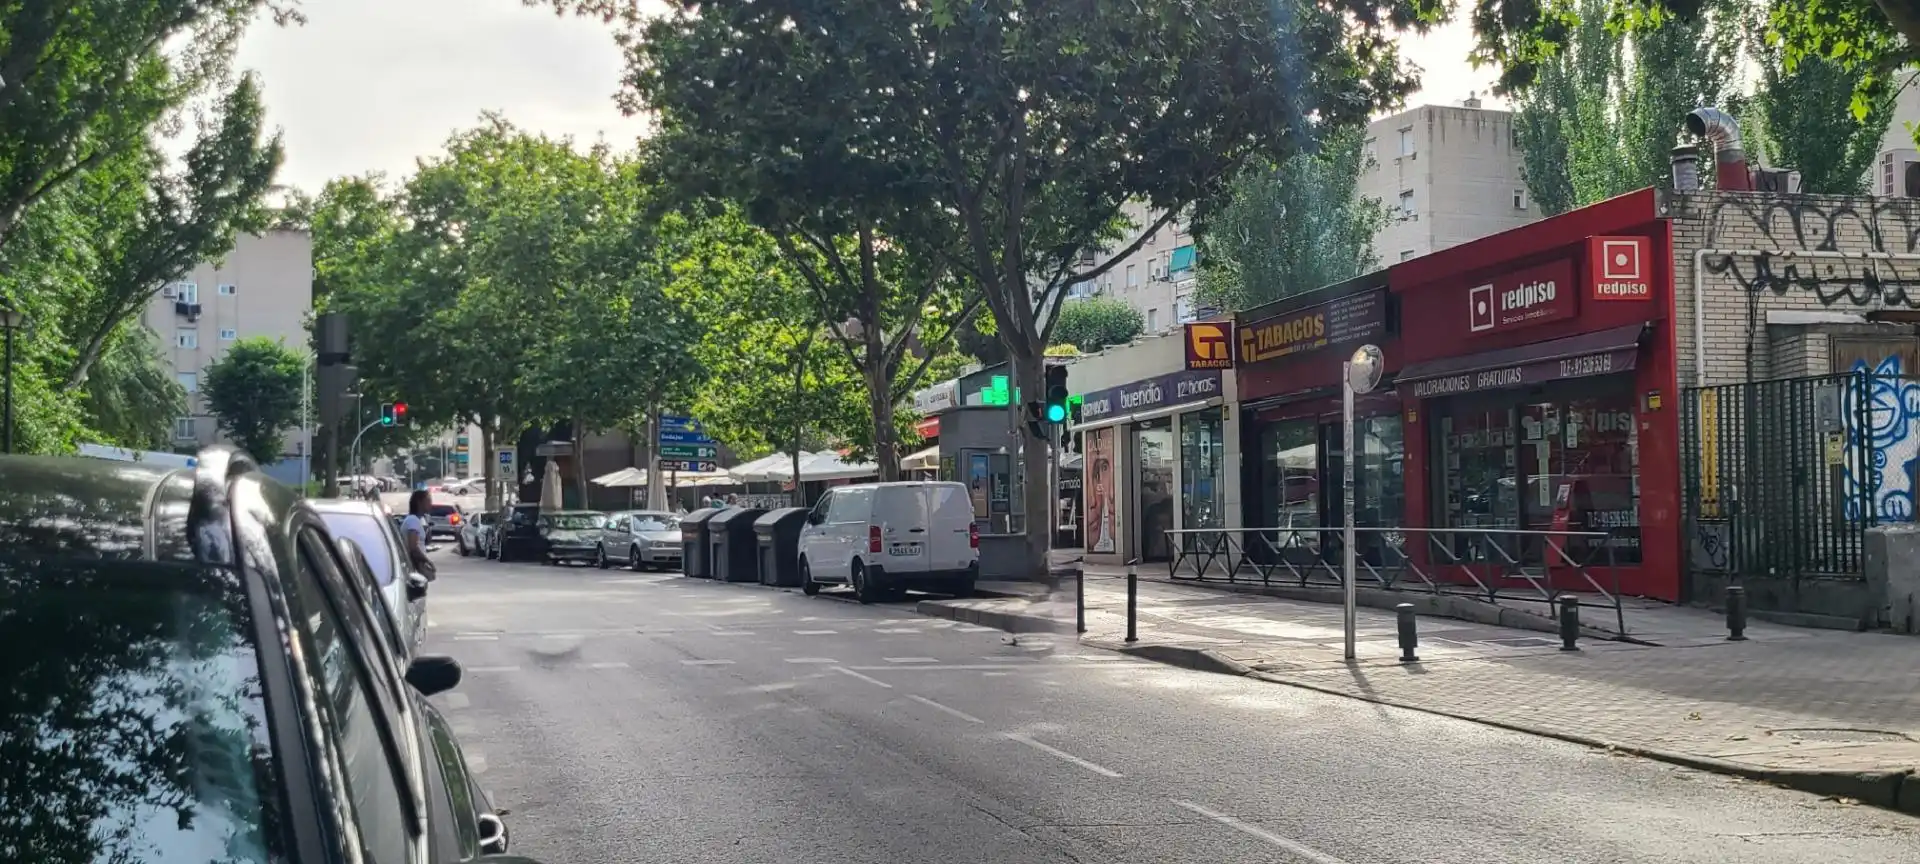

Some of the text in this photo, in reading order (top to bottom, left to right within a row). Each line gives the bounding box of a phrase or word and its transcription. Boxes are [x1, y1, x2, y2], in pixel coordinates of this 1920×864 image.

[1502, 281, 1556, 310] redpiso
[1597, 281, 1647, 296] redpiso
[1256, 312, 1325, 351] TABACOS
[1190, 359, 1232, 369] TABACOS
[1177, 381, 1189, 398] 12
[1414, 367, 1522, 397] VALORACIONES GRATUITAS
